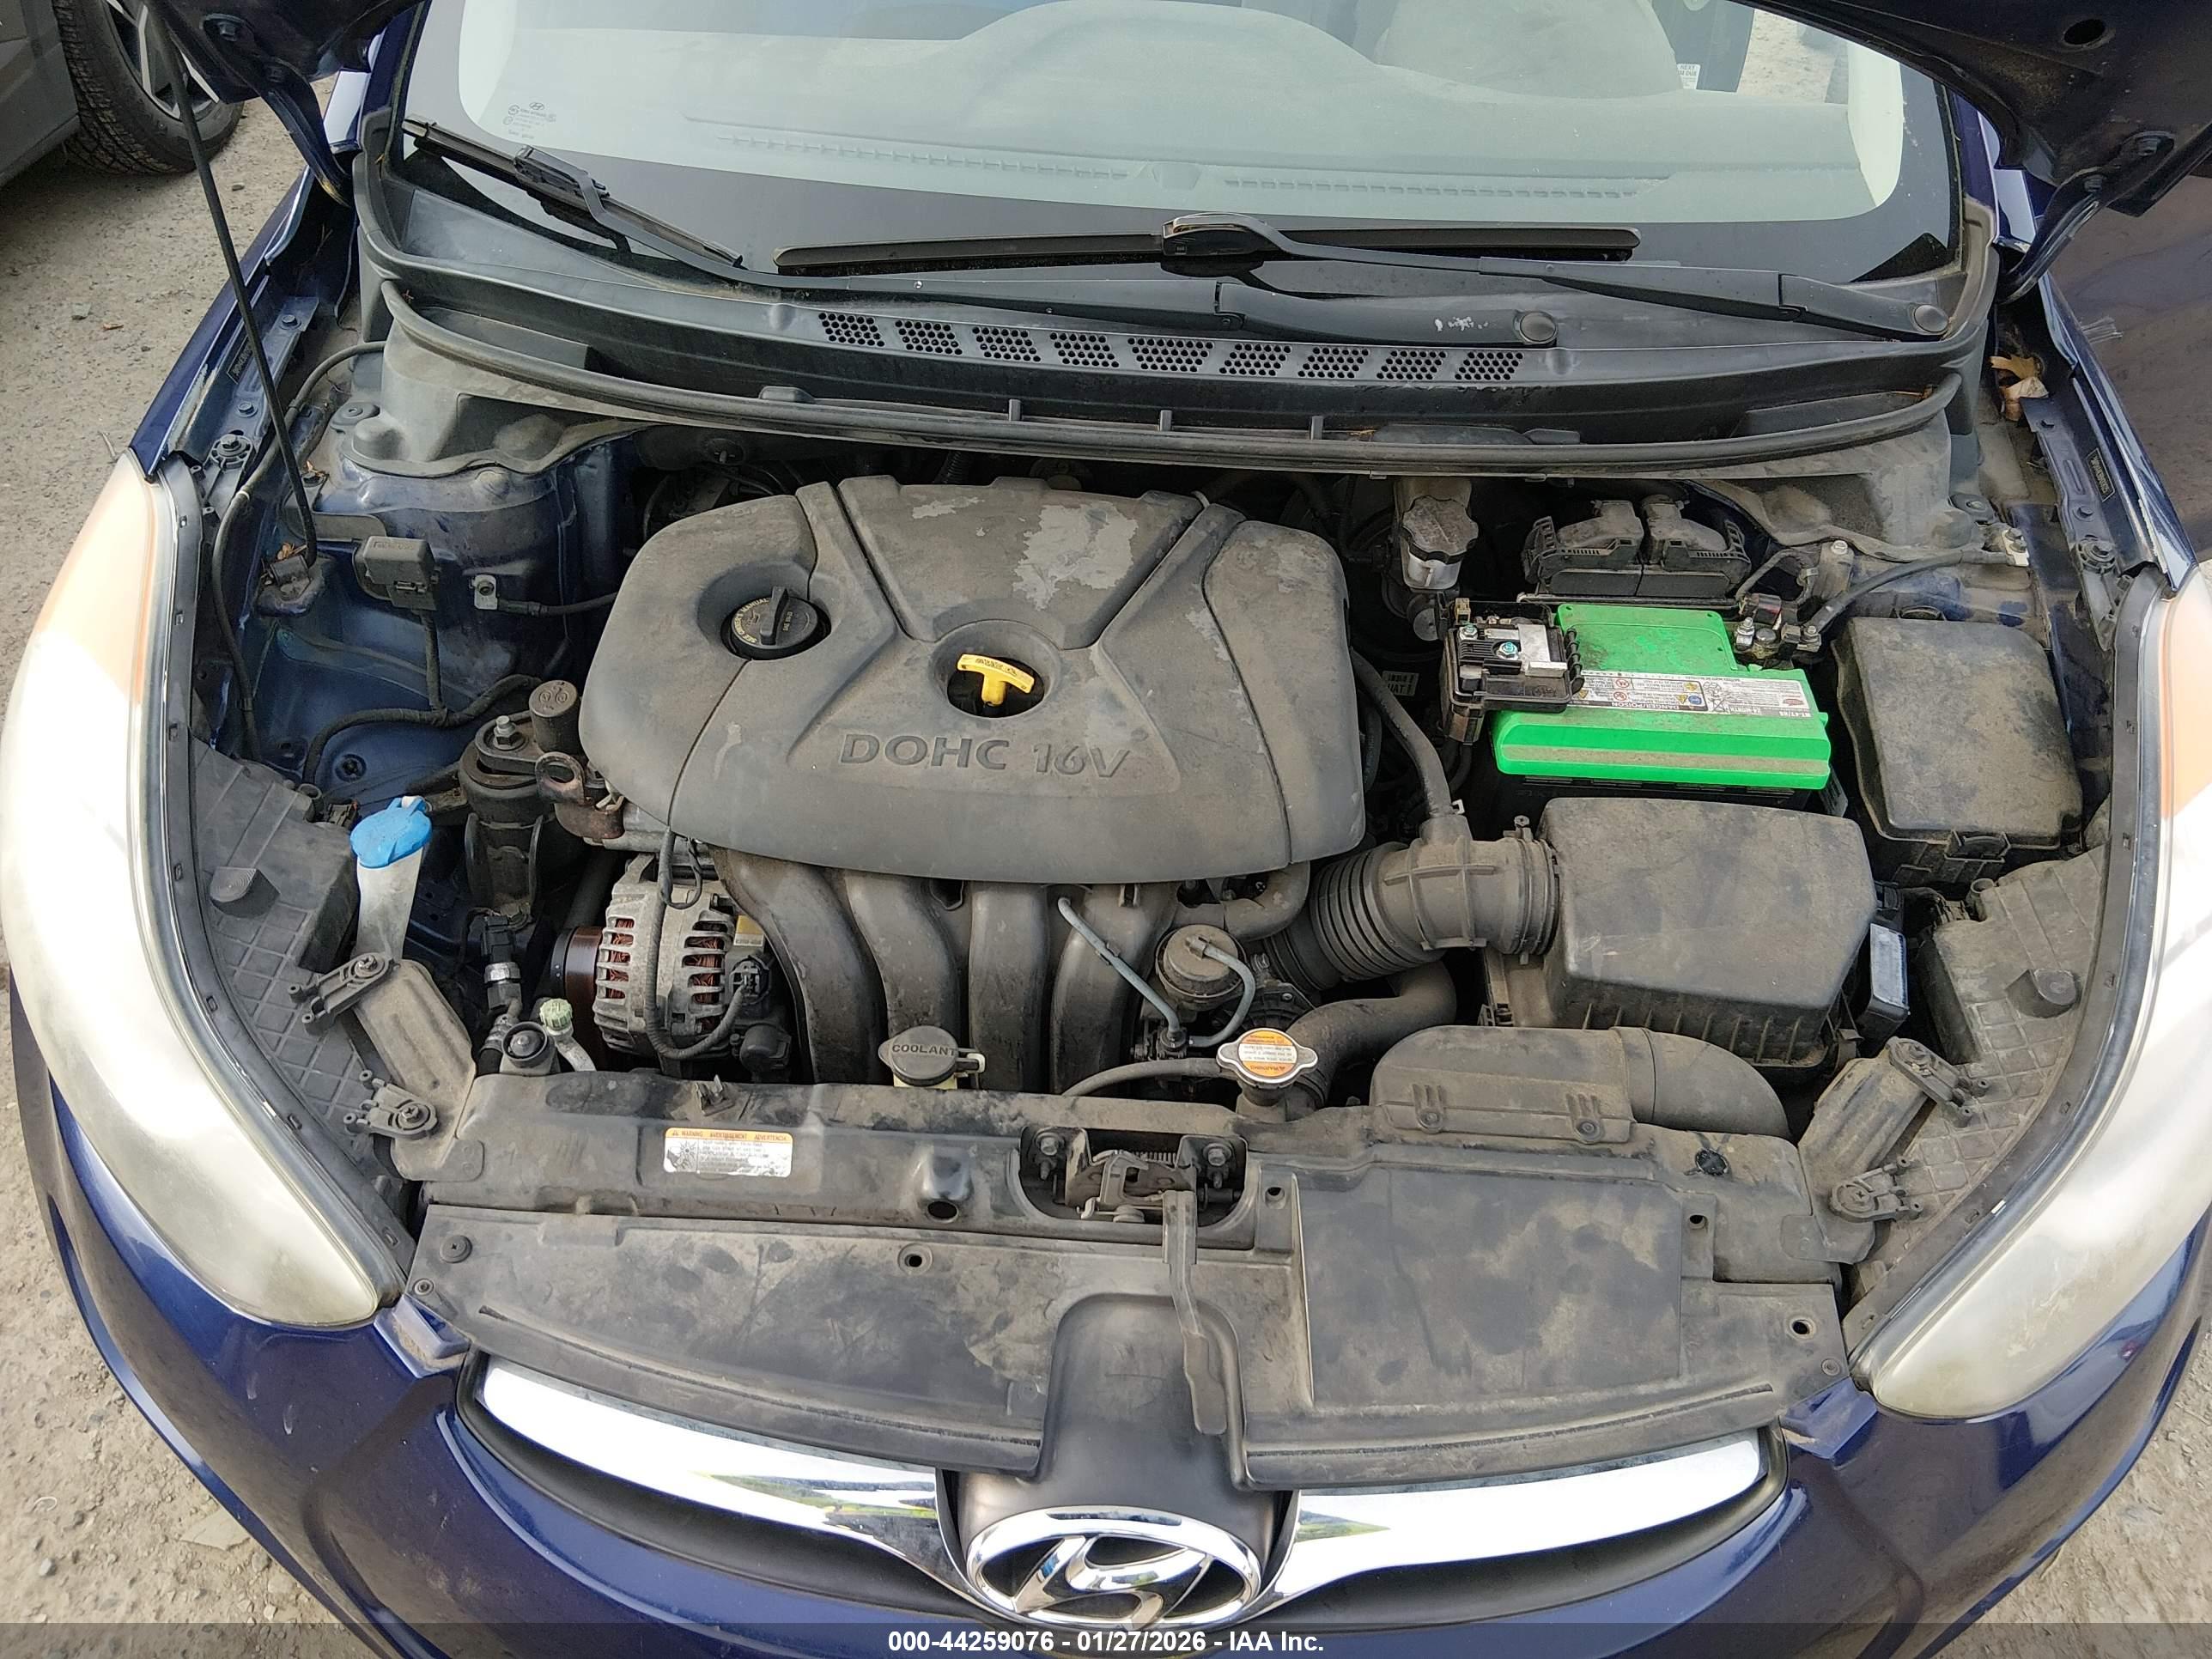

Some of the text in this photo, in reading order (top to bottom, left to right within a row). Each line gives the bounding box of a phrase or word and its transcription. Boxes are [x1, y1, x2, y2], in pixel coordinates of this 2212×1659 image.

[740, 598, 769, 612] MANUAL
[1612, 702, 1680, 710] DANGER/POISON
[840, 733, 1131, 778] DOHC 16V
[891, 1044, 955, 1056] COOLANT
